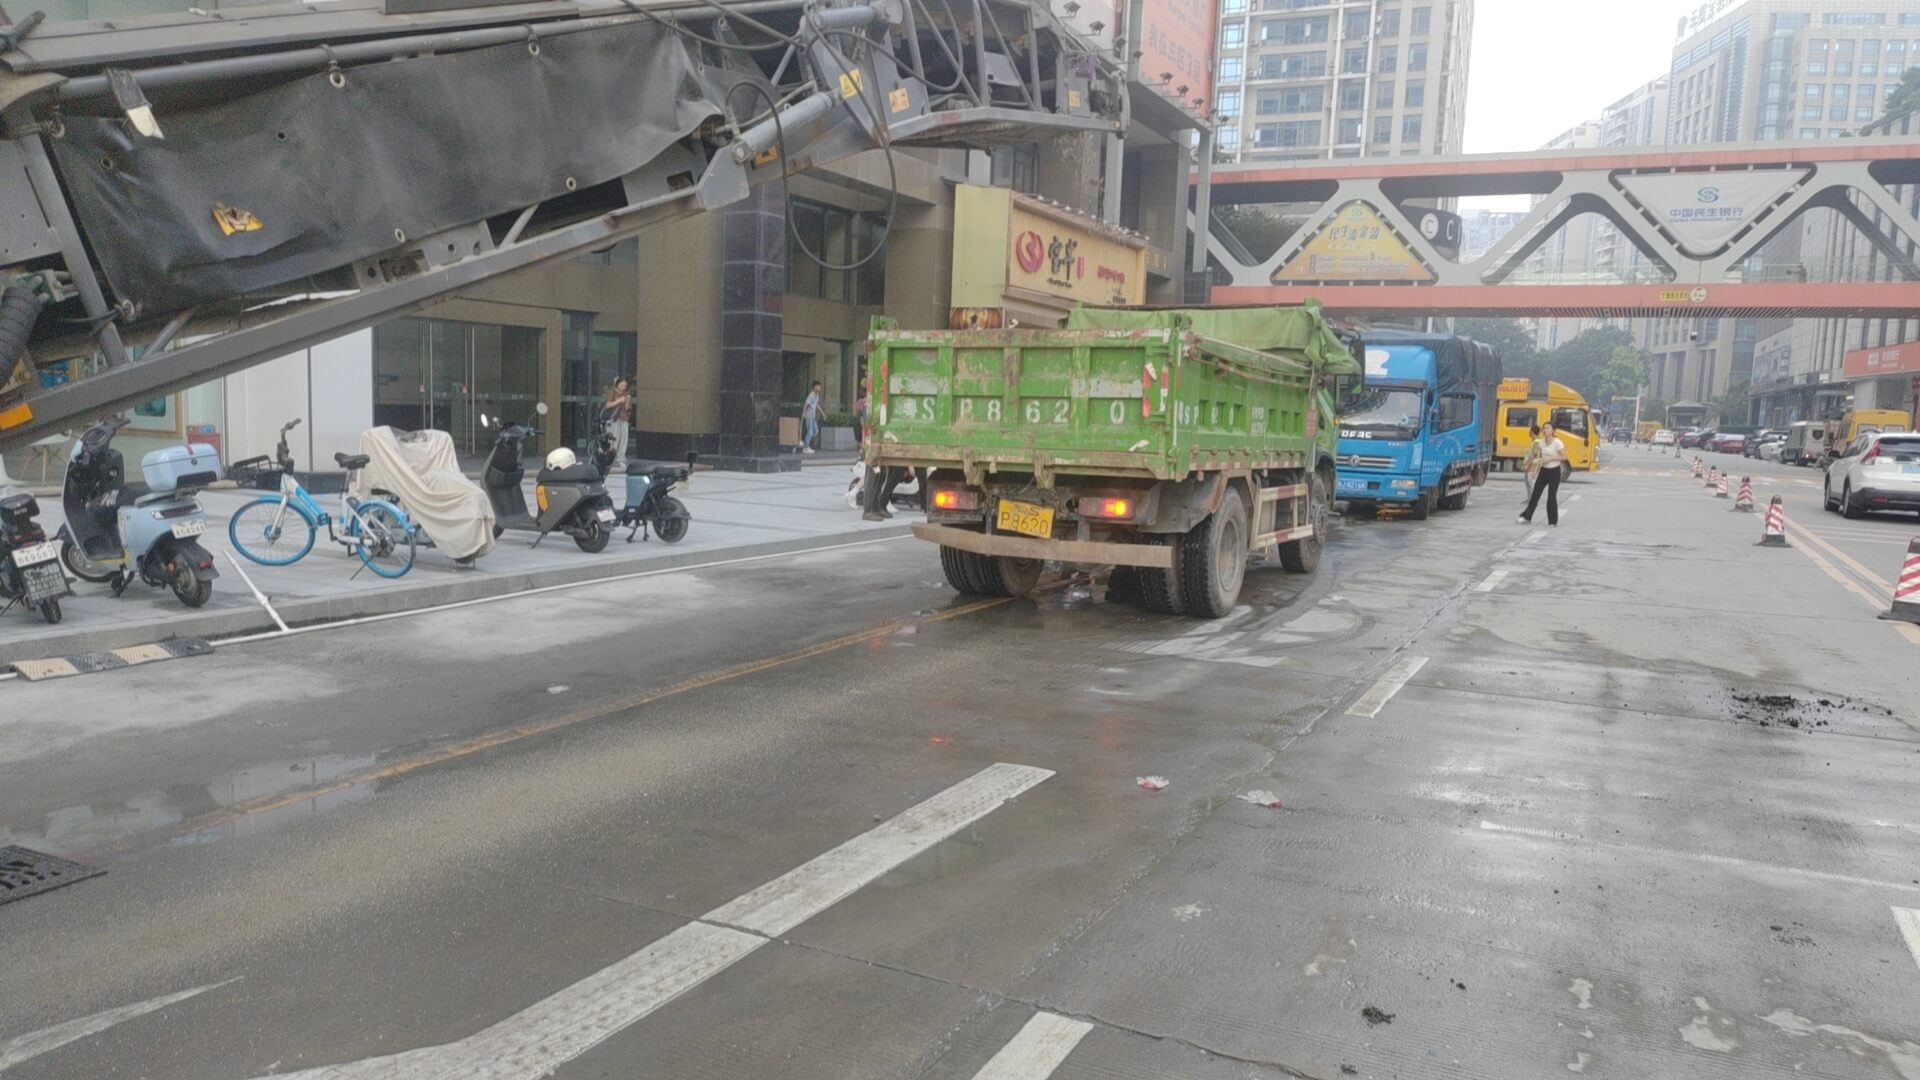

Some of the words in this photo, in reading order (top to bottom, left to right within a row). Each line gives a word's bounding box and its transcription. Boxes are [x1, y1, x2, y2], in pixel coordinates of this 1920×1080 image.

[1669, 207, 1744, 217] 中国民生银行
[1001, 511, 1049, 535] P8620
